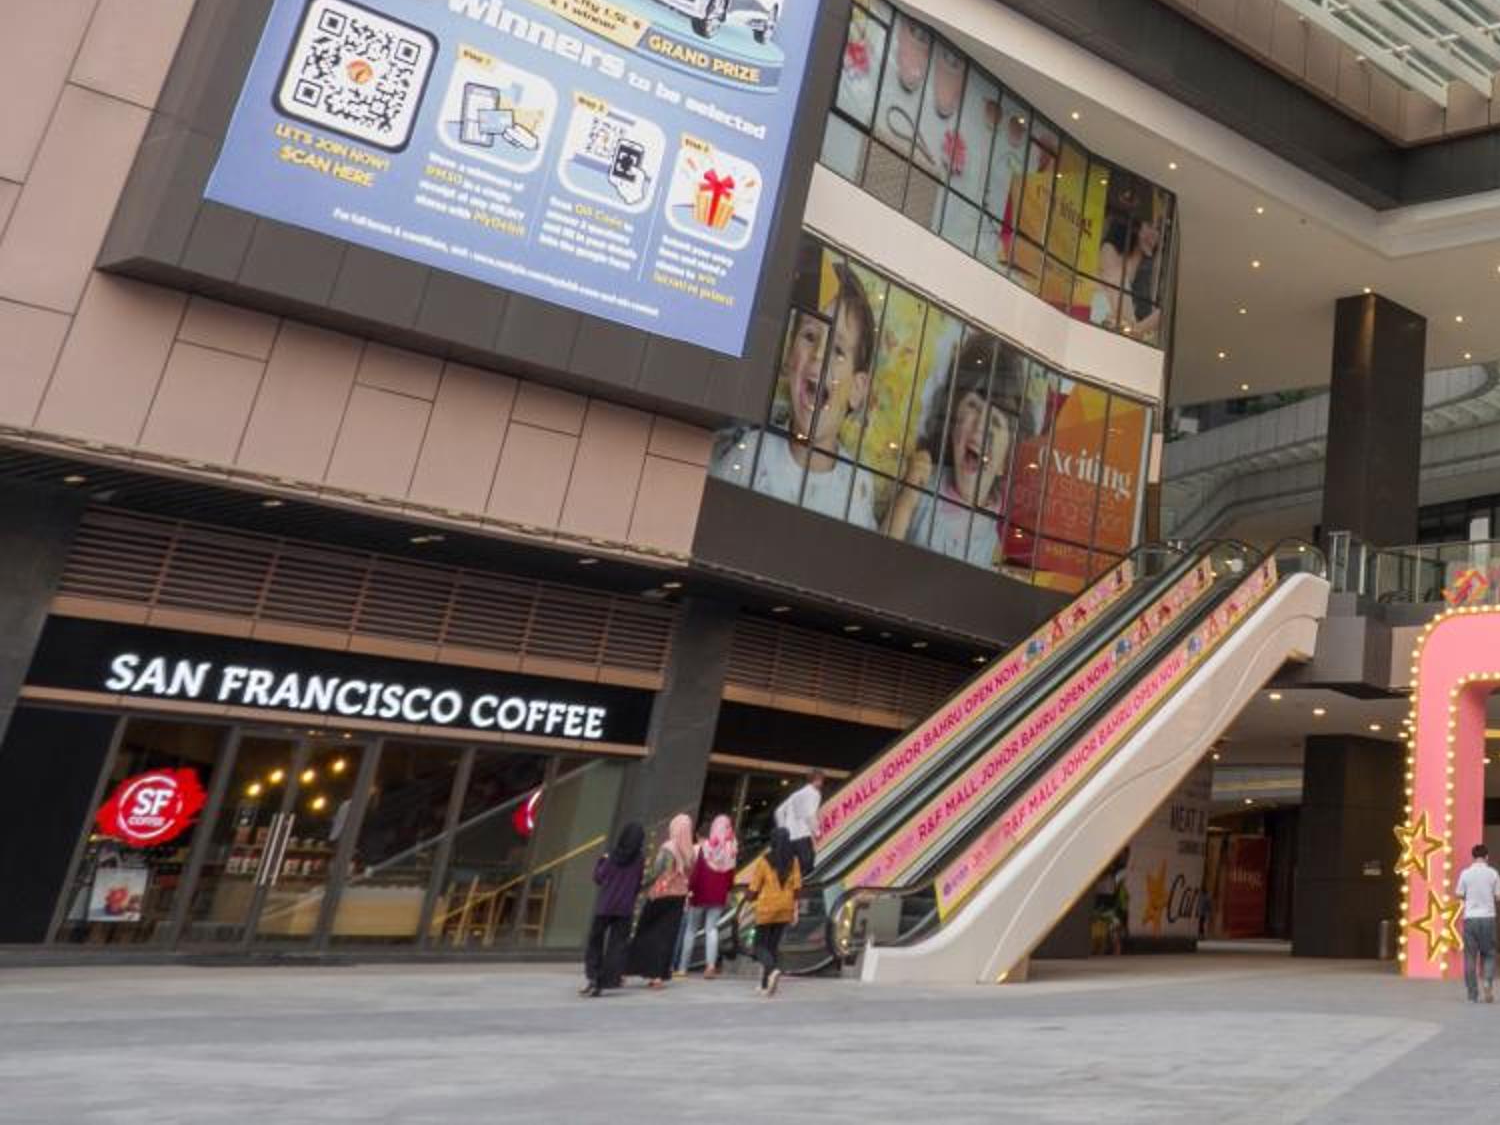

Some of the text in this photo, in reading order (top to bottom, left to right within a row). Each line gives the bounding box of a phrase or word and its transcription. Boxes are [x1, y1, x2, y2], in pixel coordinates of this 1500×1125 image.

[648, 34, 761, 83] GRAND PRIZE
[628, 72, 651, 93] to
[654, 81, 682, 105] be
[684, 94, 767, 140] selected
[279, 145, 376, 188] SCAN HERE
[1038, 446, 1132, 501] exciting
[105, 652, 608, 740] SAN FRANCISCO COFFEE
[841, 781, 879, 818] MALL
[881, 741, 922, 786] JOHOR
[923, 706, 963, 749] BAHRU
[964, 683, 994, 714] OPEN
[995, 661, 1020, 689] NOW
[917, 809, 943, 842] R&F
[944, 780, 980, 813] MALL
[981, 740, 1019, 785] JOHOR
[1021, 708, 1058, 748] BAHRU
[1058, 680, 1087, 714] OPEN
[132, 787, 174, 817] SF
[1028, 779, 1059, 811] MALL
